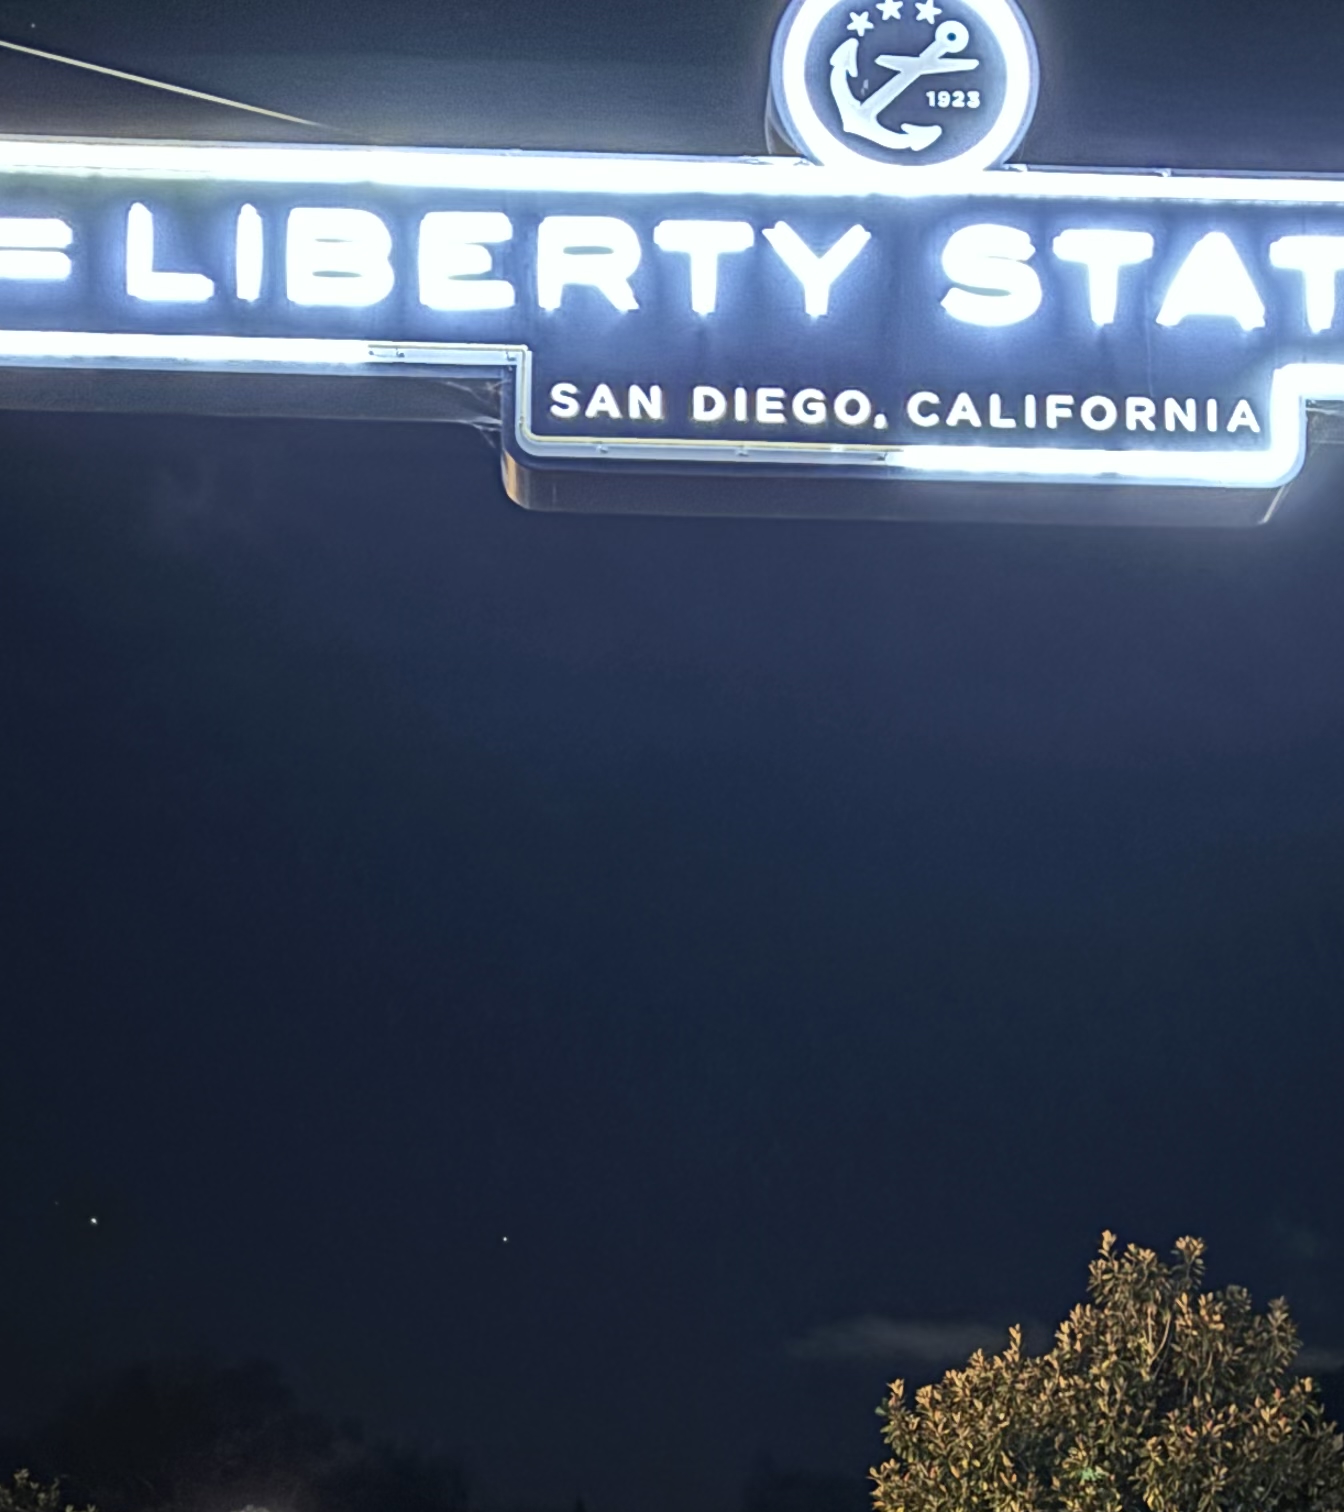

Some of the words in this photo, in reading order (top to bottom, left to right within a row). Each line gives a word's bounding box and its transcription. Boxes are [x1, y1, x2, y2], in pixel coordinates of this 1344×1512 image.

[925, 90, 981, 109] 1923
[124, 201, 873, 320] LIBERTY
[549, 382, 663, 421] SAN
[692, 385, 888, 430] DIEGO,
[905, 390, 1263, 435] CALIFORNIA
